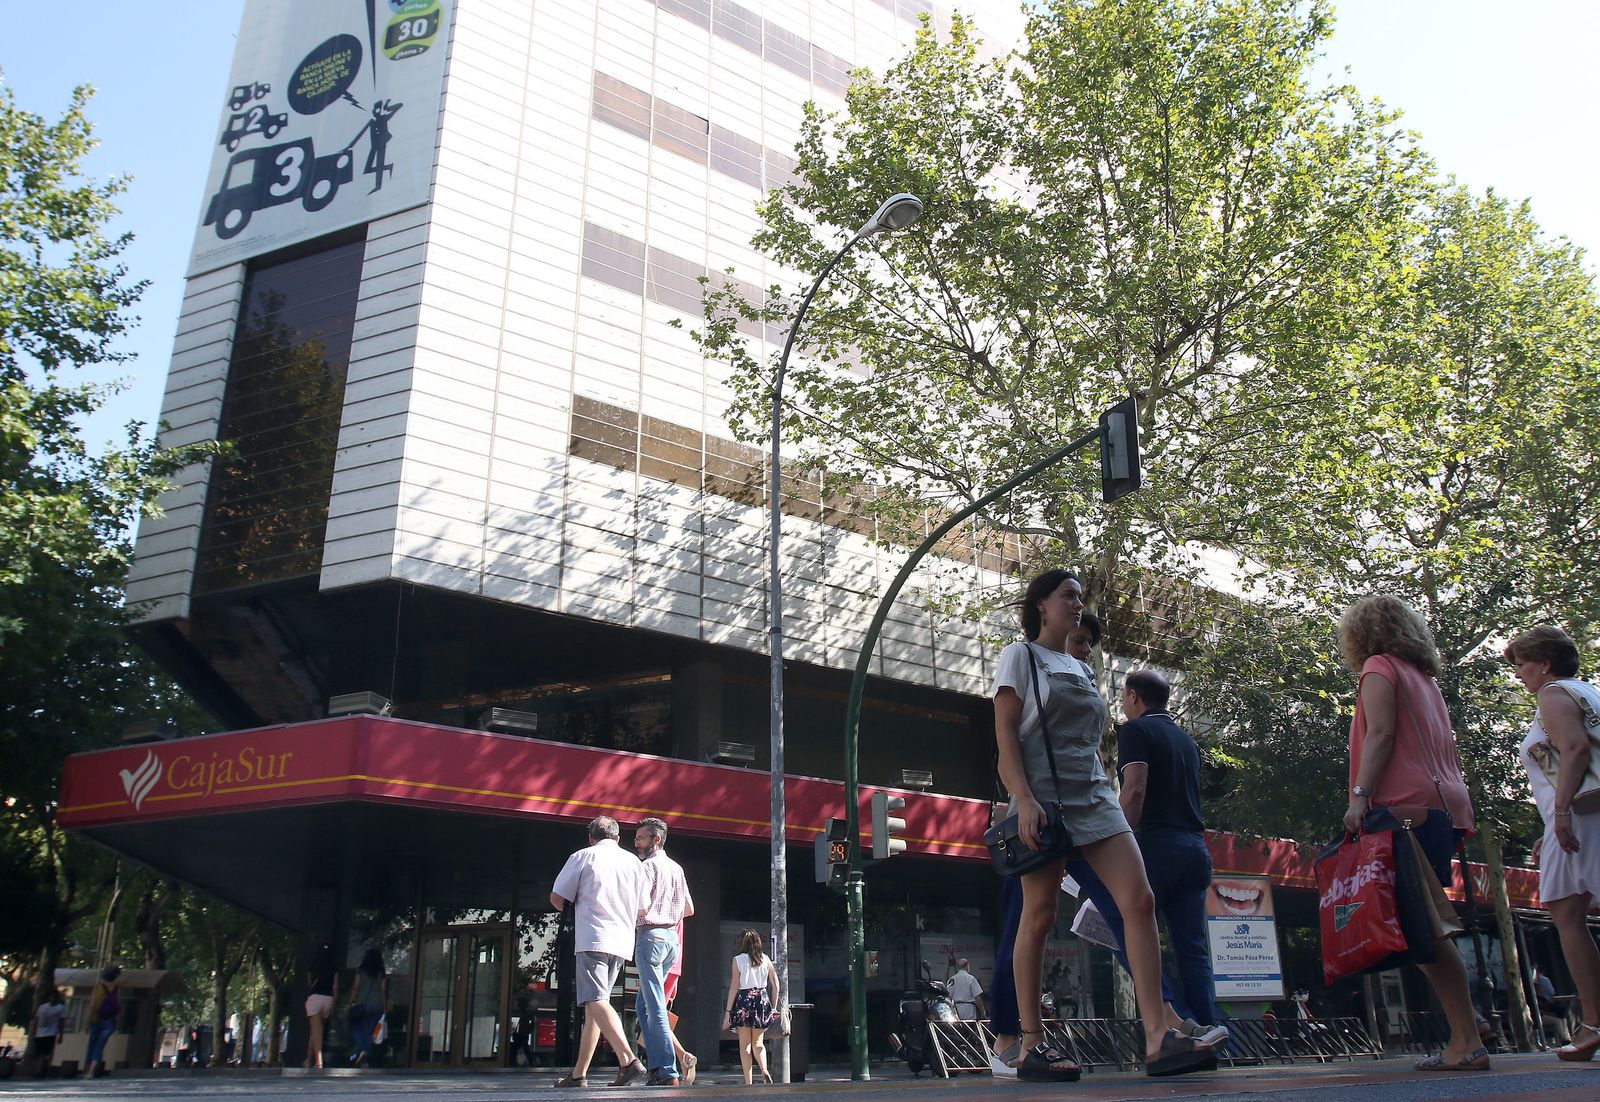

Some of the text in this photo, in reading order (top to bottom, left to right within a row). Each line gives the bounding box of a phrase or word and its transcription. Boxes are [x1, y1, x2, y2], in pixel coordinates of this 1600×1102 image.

[398, 18, 428, 42] 30
[249, 85, 256, 98] 1
[246, 107, 263, 131] 2
[269, 146, 305, 197] 3
[166, 746, 293, 798] CajaSur
[1226, 941, 1262, 949] Jesús María
